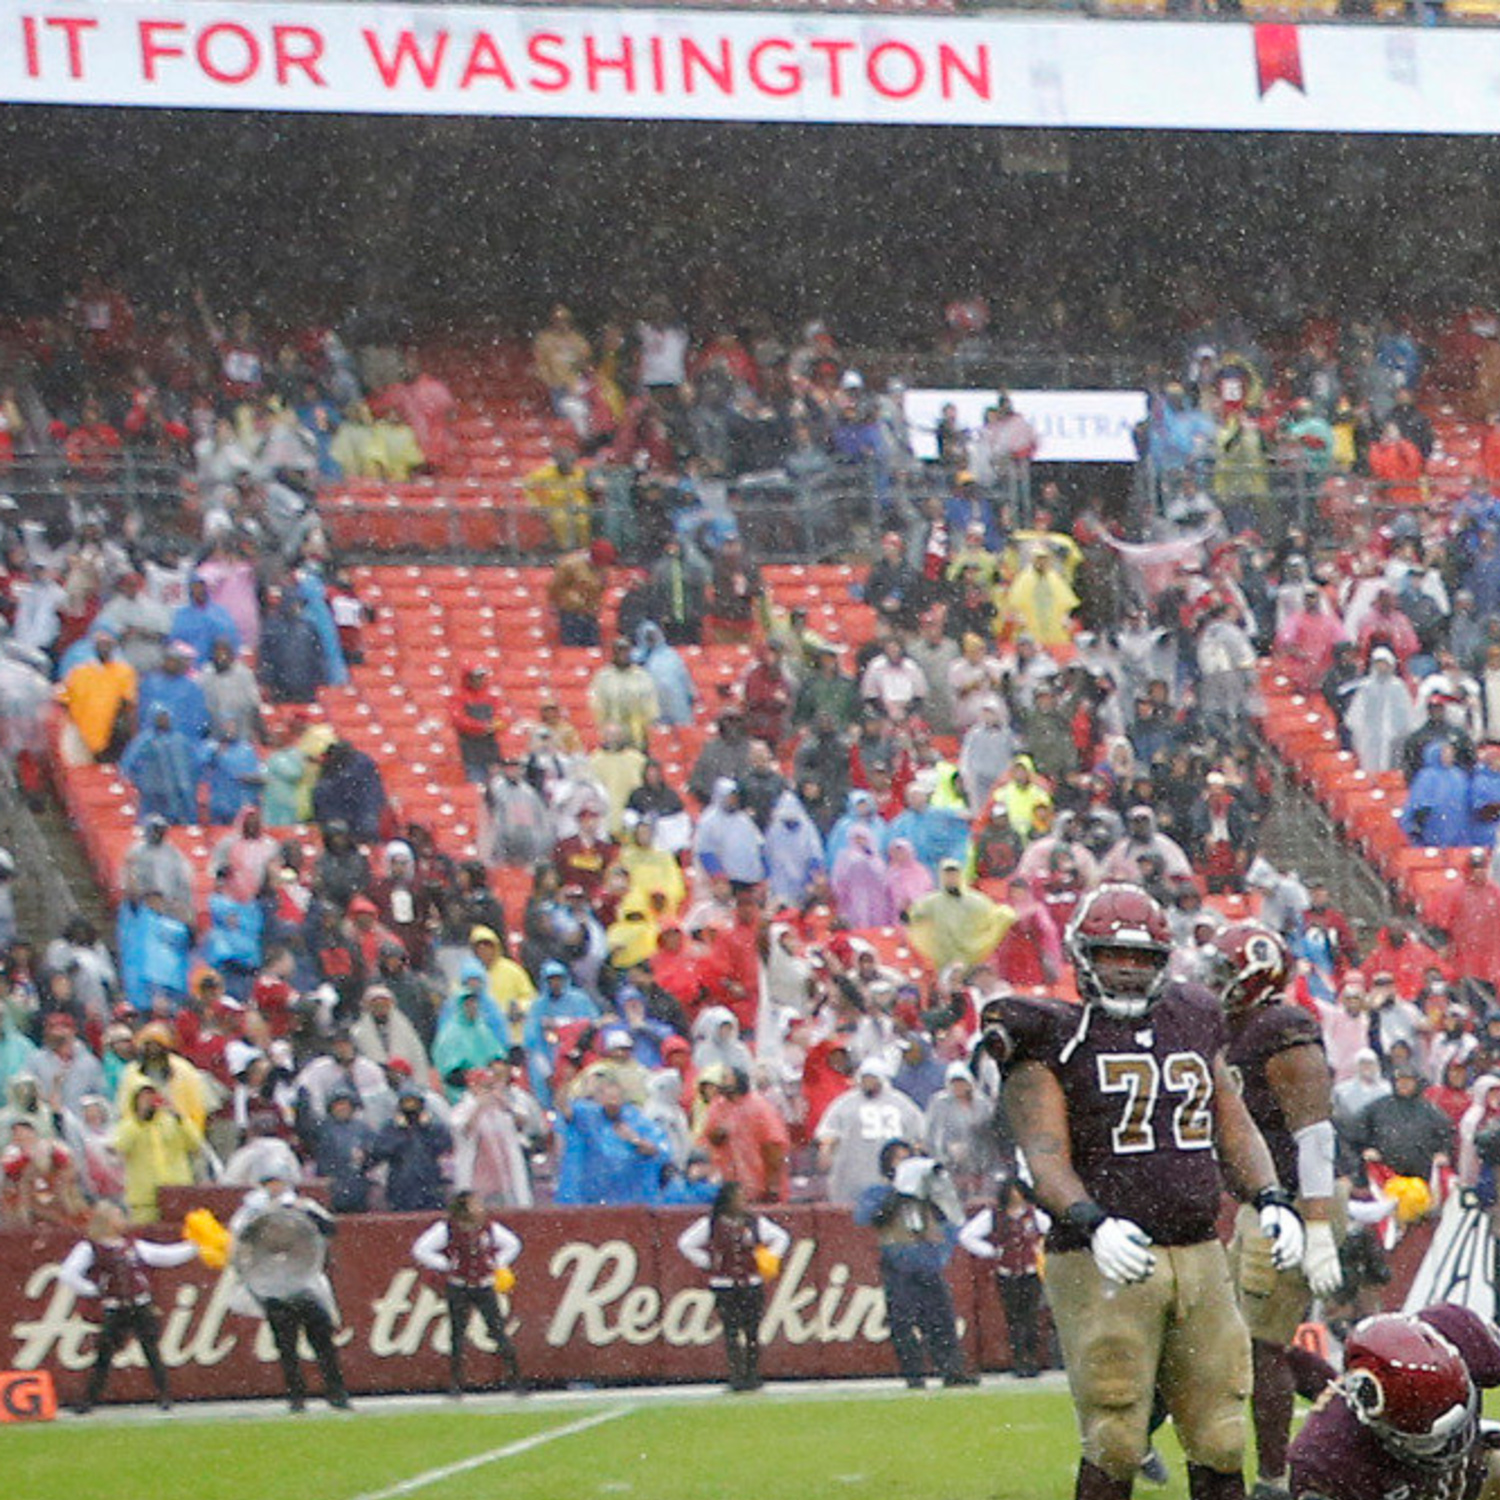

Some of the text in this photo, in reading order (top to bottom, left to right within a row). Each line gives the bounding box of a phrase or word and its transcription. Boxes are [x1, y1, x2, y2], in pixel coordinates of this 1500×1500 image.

[22, 16, 992, 101] IT FOR WASHINGTON
[1096, 1052, 1213, 1154] 72
[547, 1238, 966, 1348] Rekin
[3, 1377, 43, 1417] G
